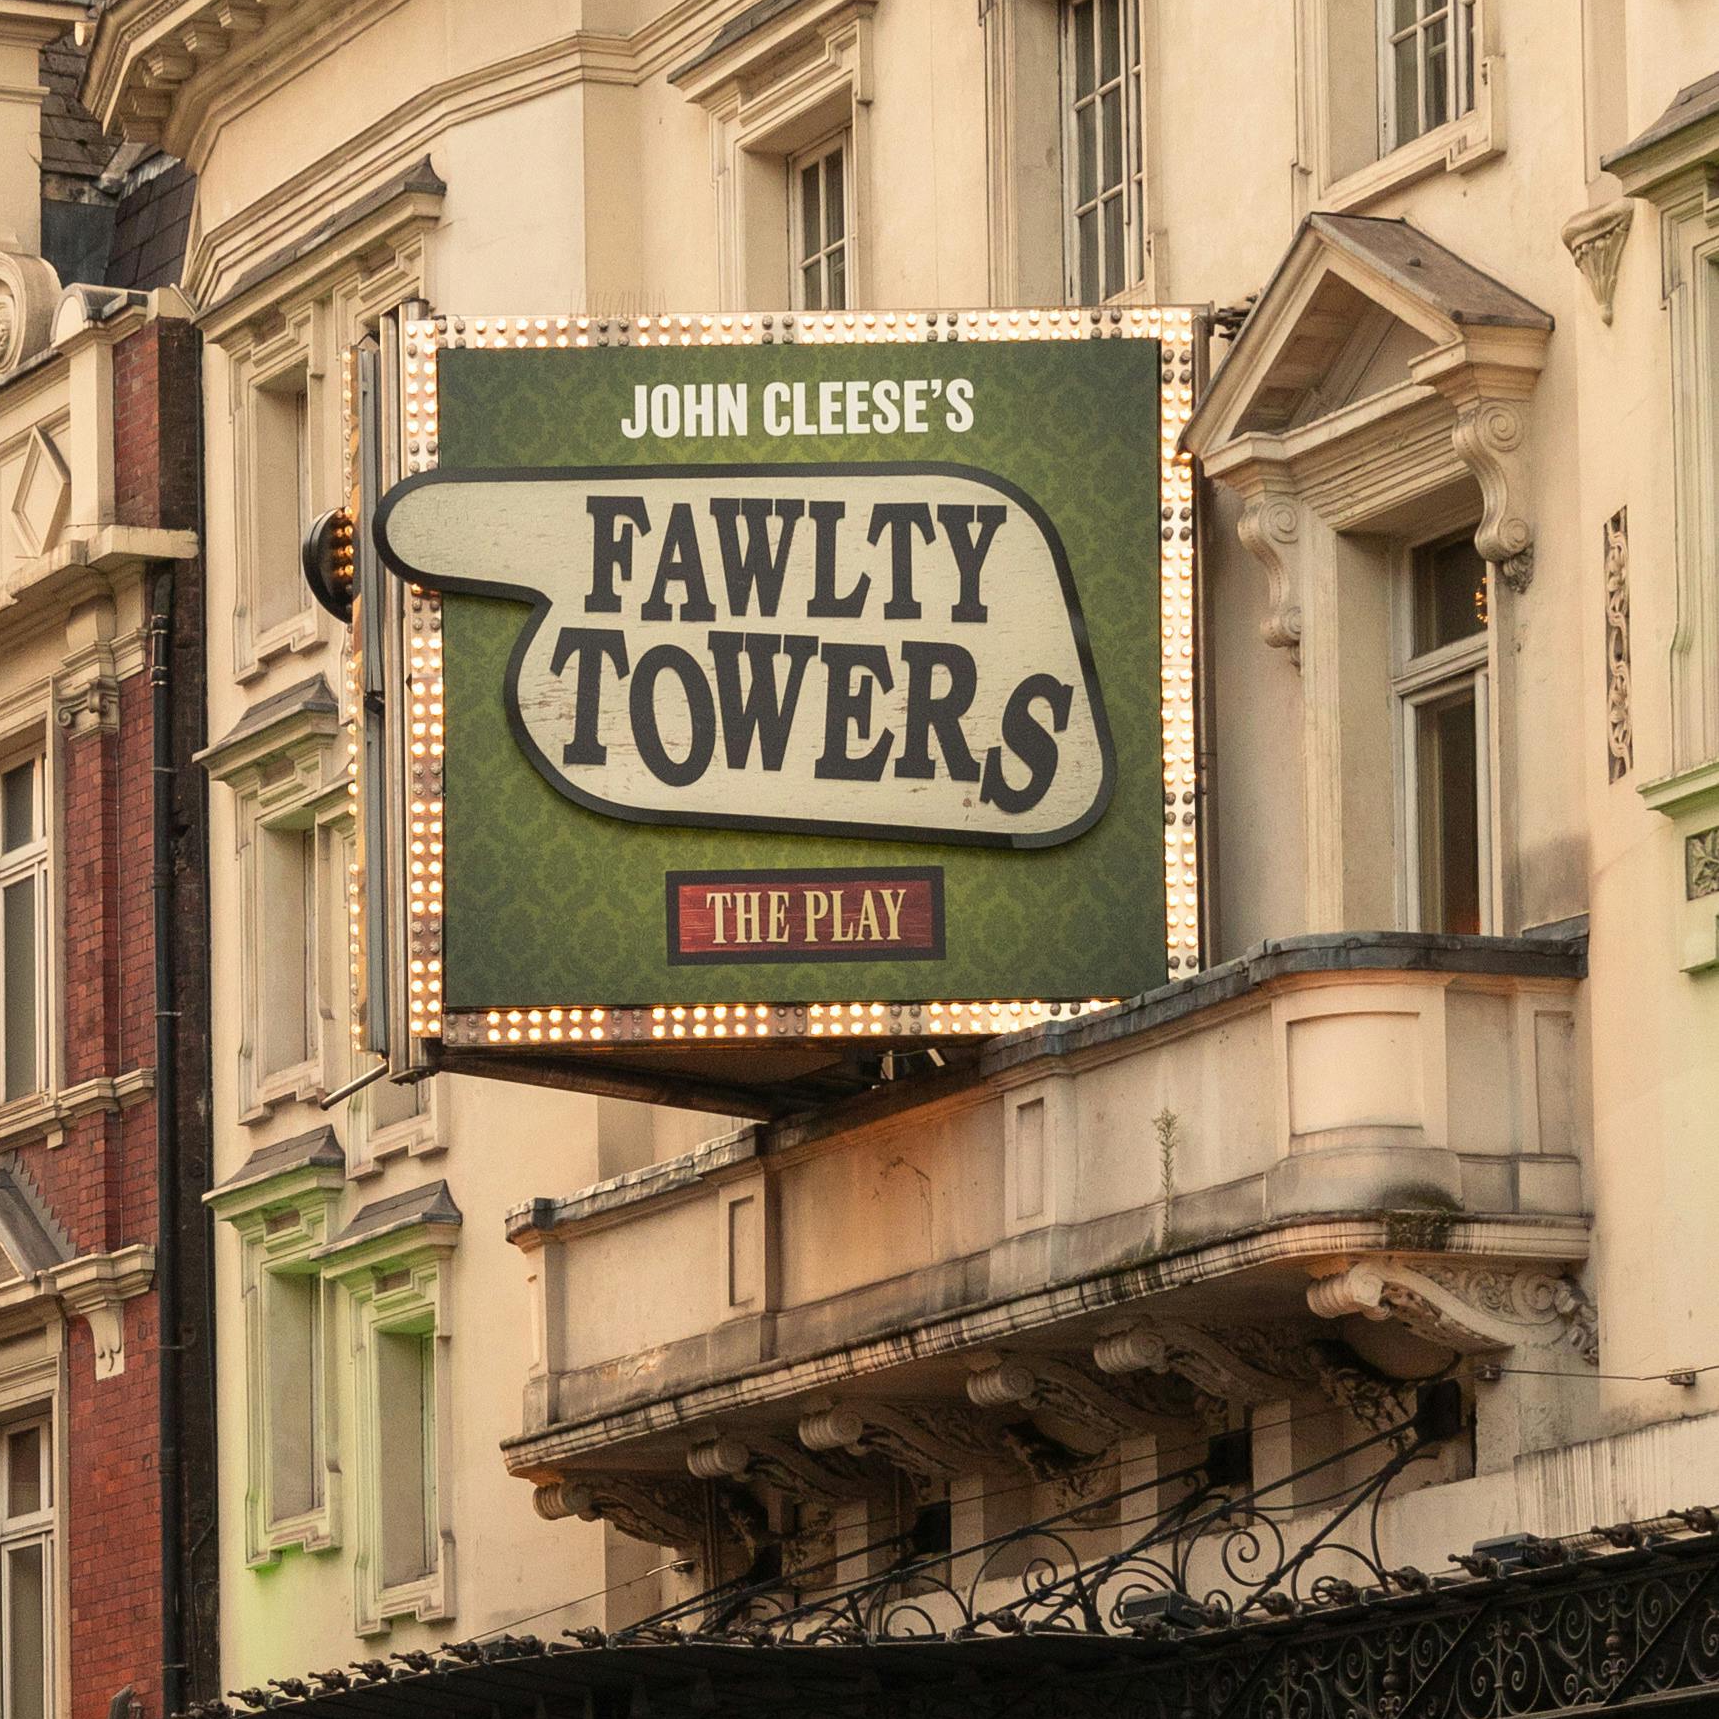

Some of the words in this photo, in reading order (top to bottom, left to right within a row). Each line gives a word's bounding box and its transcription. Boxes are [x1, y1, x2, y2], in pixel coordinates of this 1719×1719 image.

[620, 385, 748, 439] JOHN
[763, 378, 975, 436] CLEESE'S
[584, 494, 1008, 624] FAWLTY
[550, 627, 1074, 815] TOWERS
[705, 890, 791, 946] THE
[803, 888, 907, 944] PLAY
